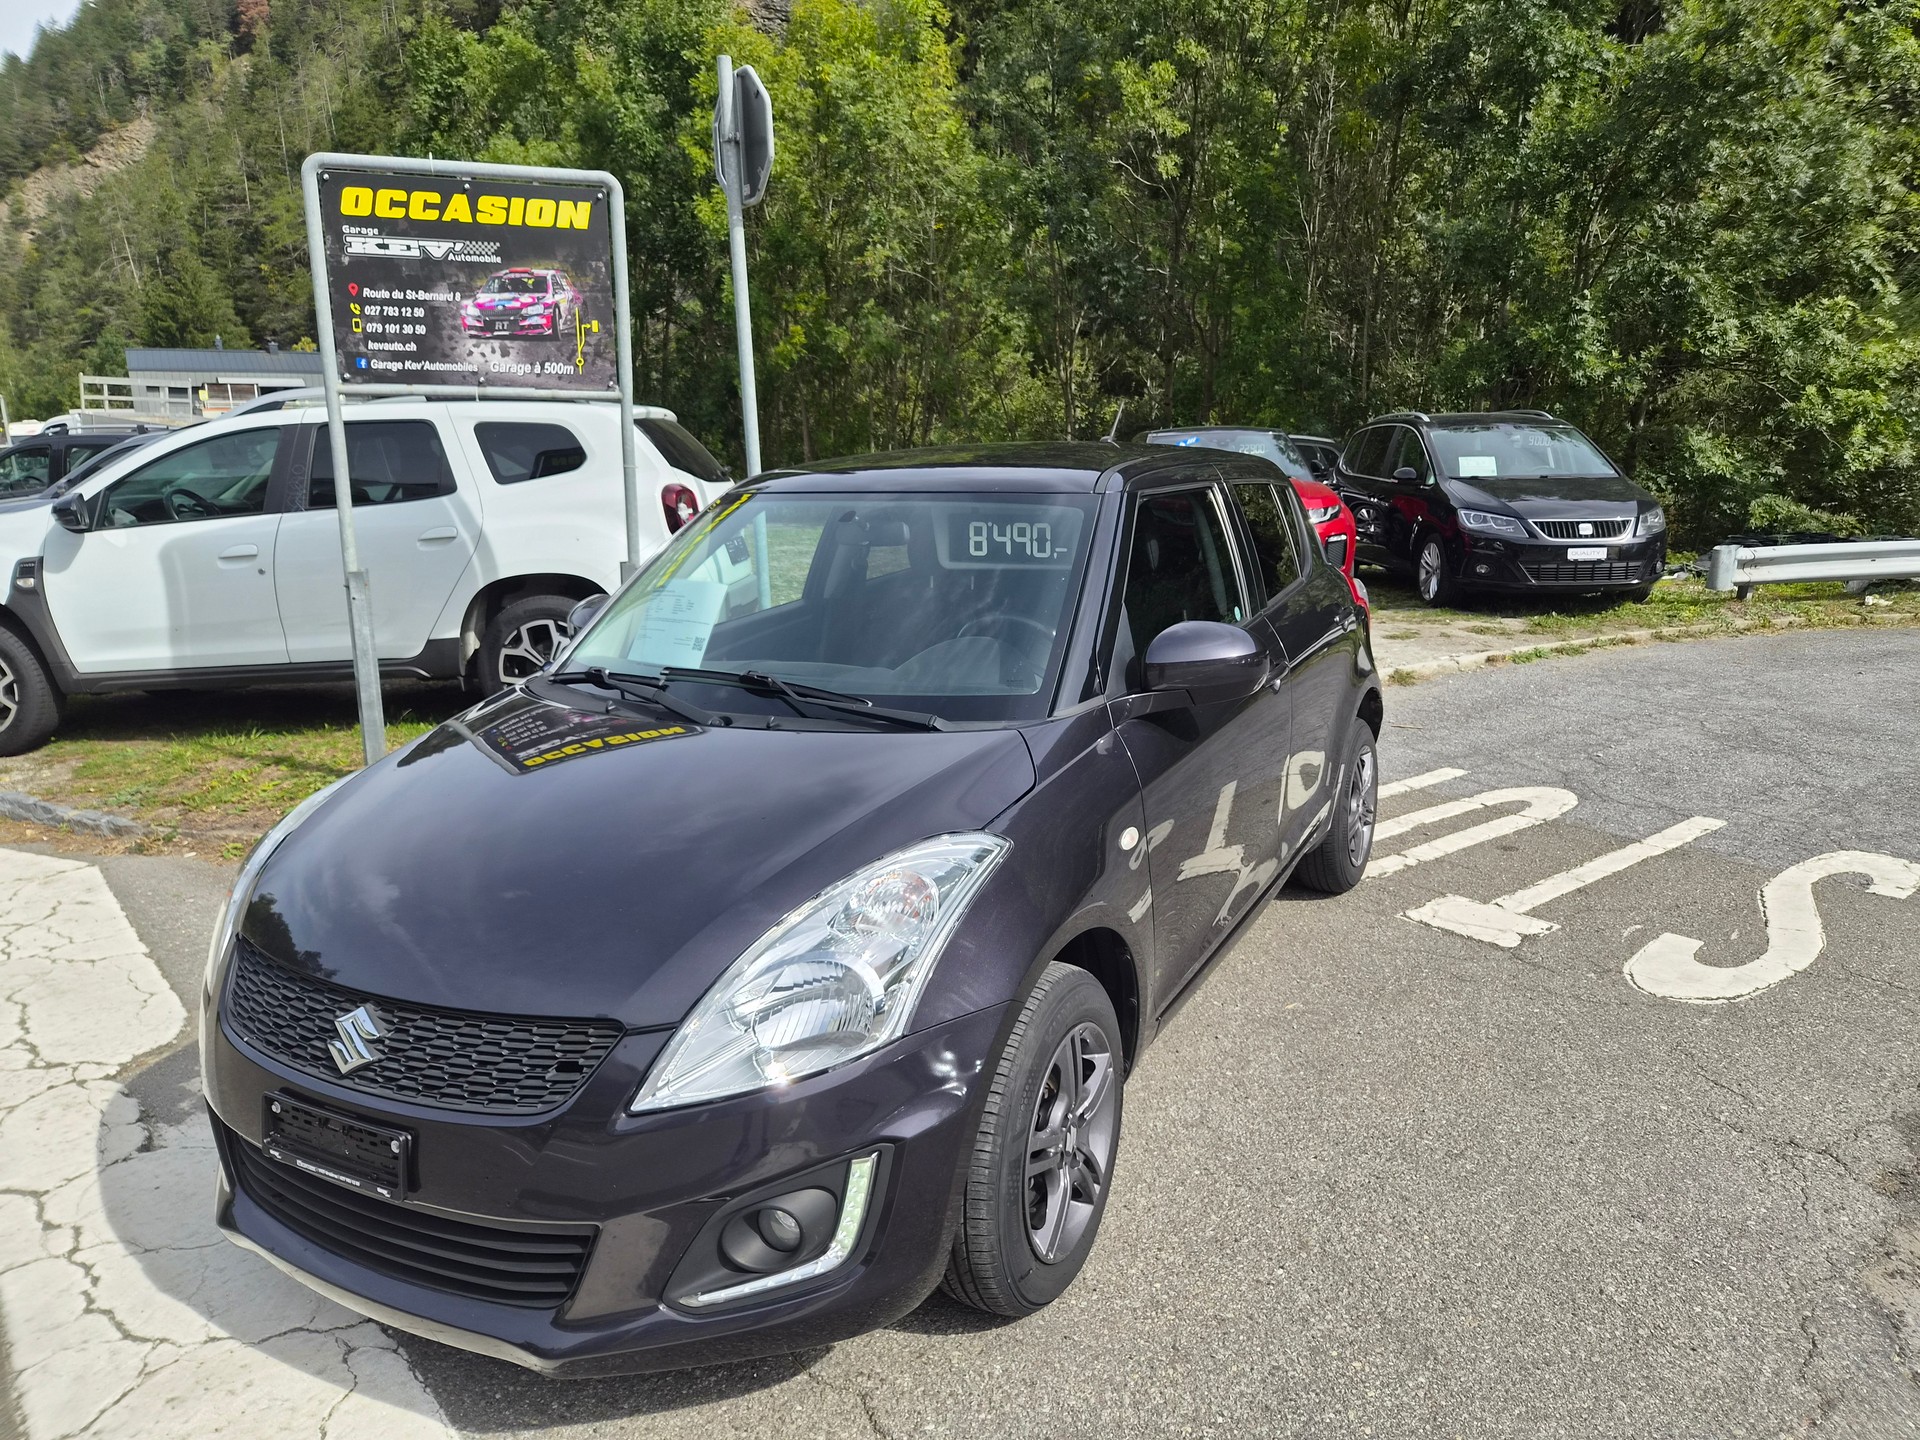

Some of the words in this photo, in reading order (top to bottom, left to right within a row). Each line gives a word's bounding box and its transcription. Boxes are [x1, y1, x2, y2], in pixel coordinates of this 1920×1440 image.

[341, 187, 591, 229] OCCASION
[342, 225, 379, 236] Garage
[448, 253, 501, 263] Automobile
[363, 288, 389, 299] Route
[392, 289, 404, 300] du
[406, 290, 453, 302] St-Bernard
[455, 292, 461, 302] 8
[365, 305, 381, 316] 027
[383, 306, 399, 317] 783
[401, 307, 412, 317] 12
[413, 307, 425, 318] 50
[366, 323, 382, 333] 079
[385, 323, 400, 334] 101
[402, 324, 413, 334] 30
[415, 325, 426, 335] 50
[368, 340, 417, 352] kevauto.ch
[371, 359, 403, 372] Garage
[405, 360, 478, 372] Kev'Automobiles
[490, 362, 531, 375] Garage
[534, 362, 541, 372] à
[544, 363, 574, 375] 500m
